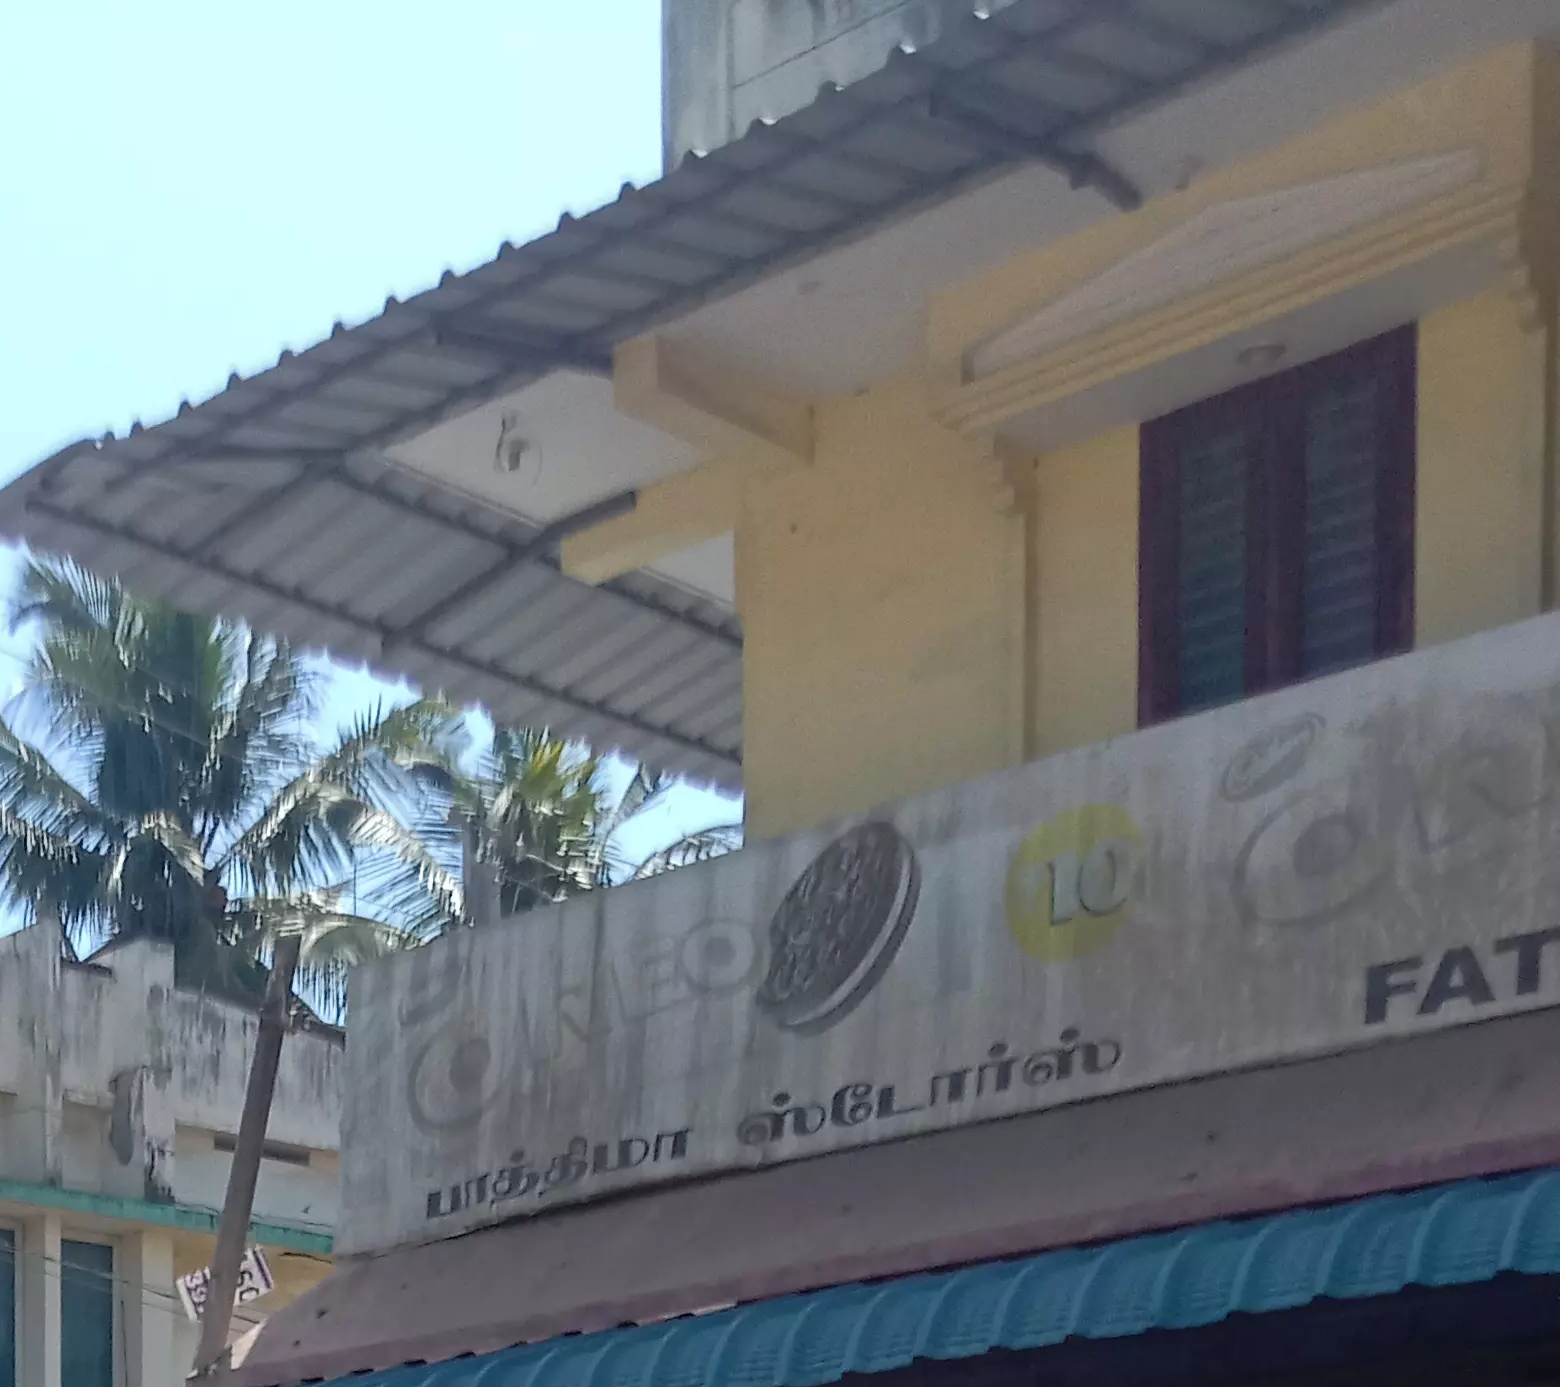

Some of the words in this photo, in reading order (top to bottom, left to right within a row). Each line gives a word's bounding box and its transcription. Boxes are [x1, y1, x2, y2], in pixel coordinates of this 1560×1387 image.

[1364, 926, 1560, 1025] FAT
[426, 1127, 693, 1220] பாத்திமா
[738, 1027, 1122, 1147] ஸ்டோர்ஸ்
